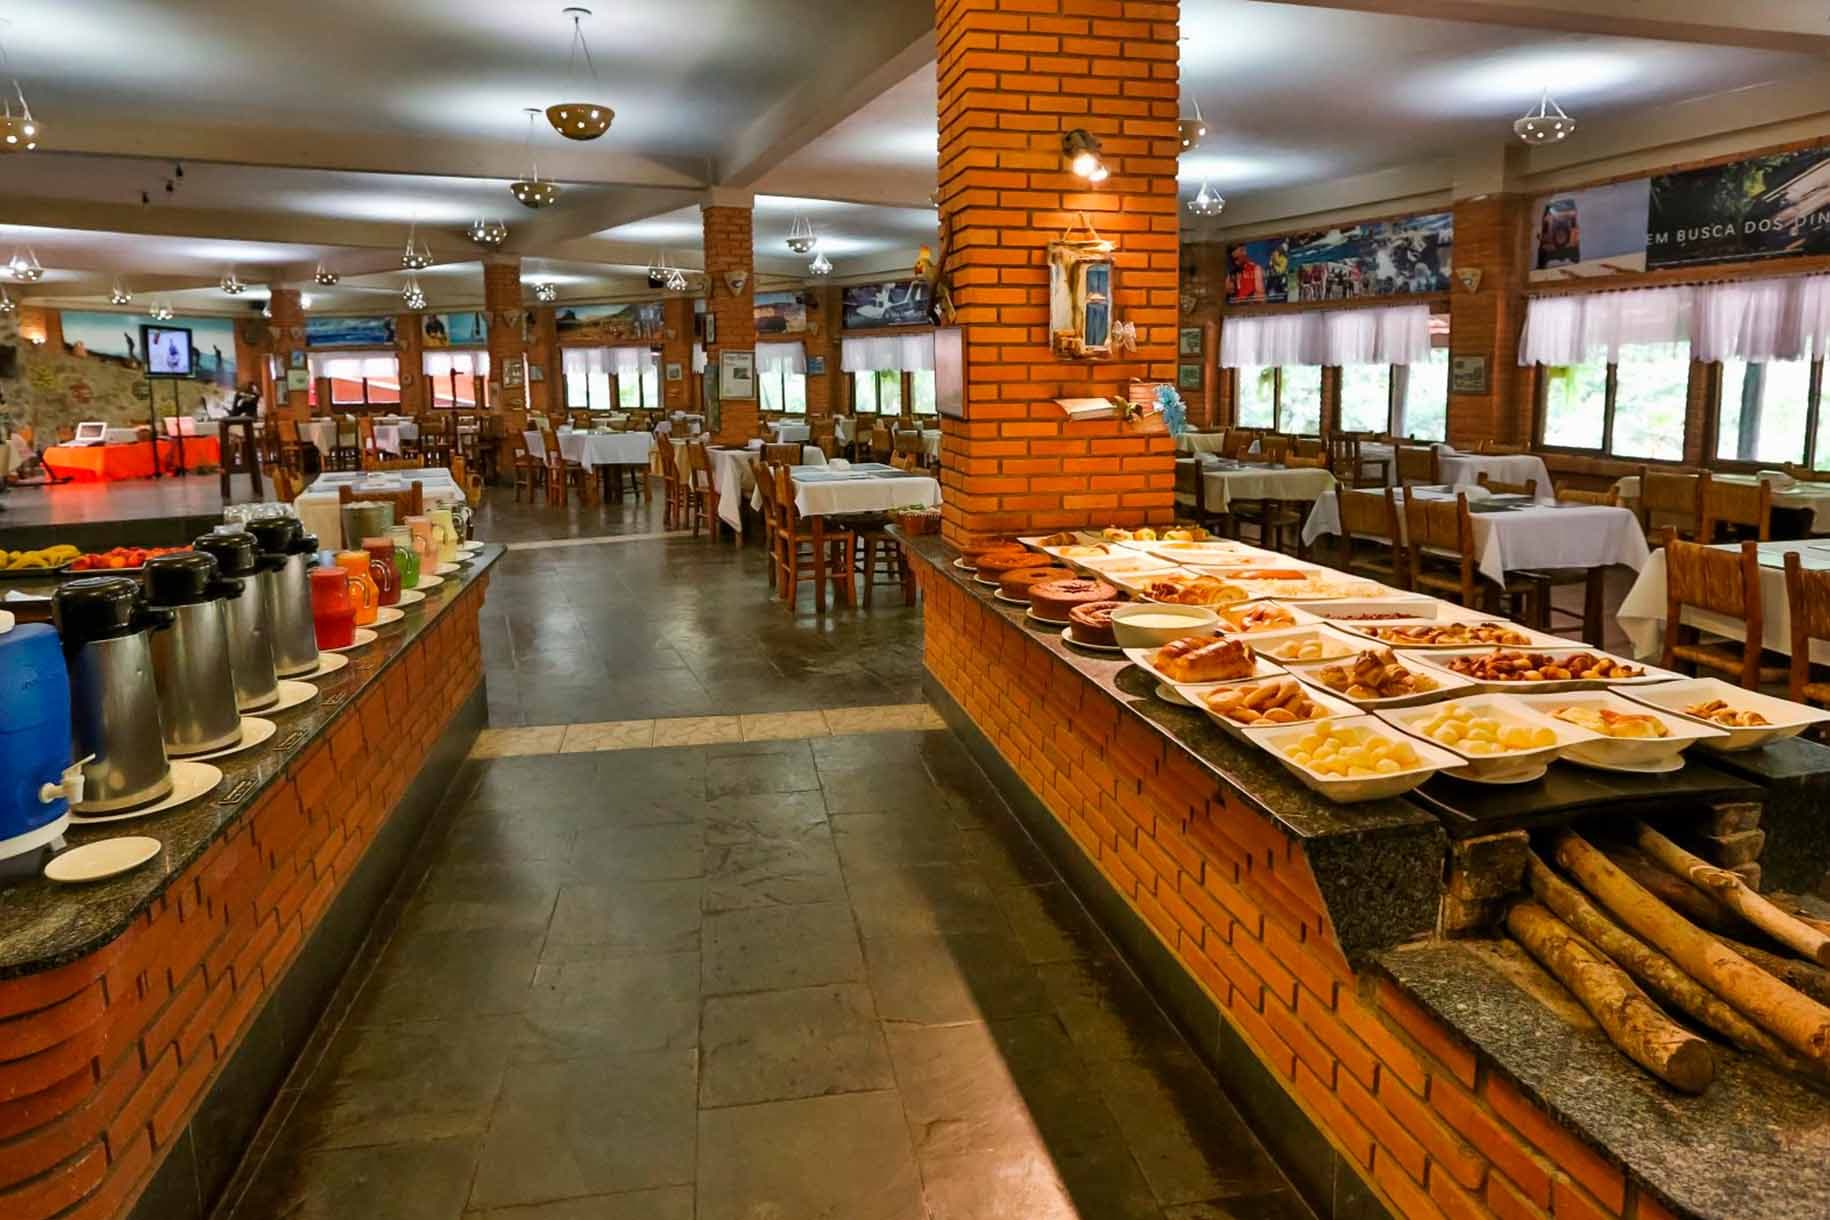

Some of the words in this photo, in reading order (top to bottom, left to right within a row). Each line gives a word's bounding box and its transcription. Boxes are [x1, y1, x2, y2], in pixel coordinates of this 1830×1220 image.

[1647, 232, 1668, 245] EM
[1677, 223, 1736, 243] BUSCA
[1744, 219, 1783, 234] DOS
